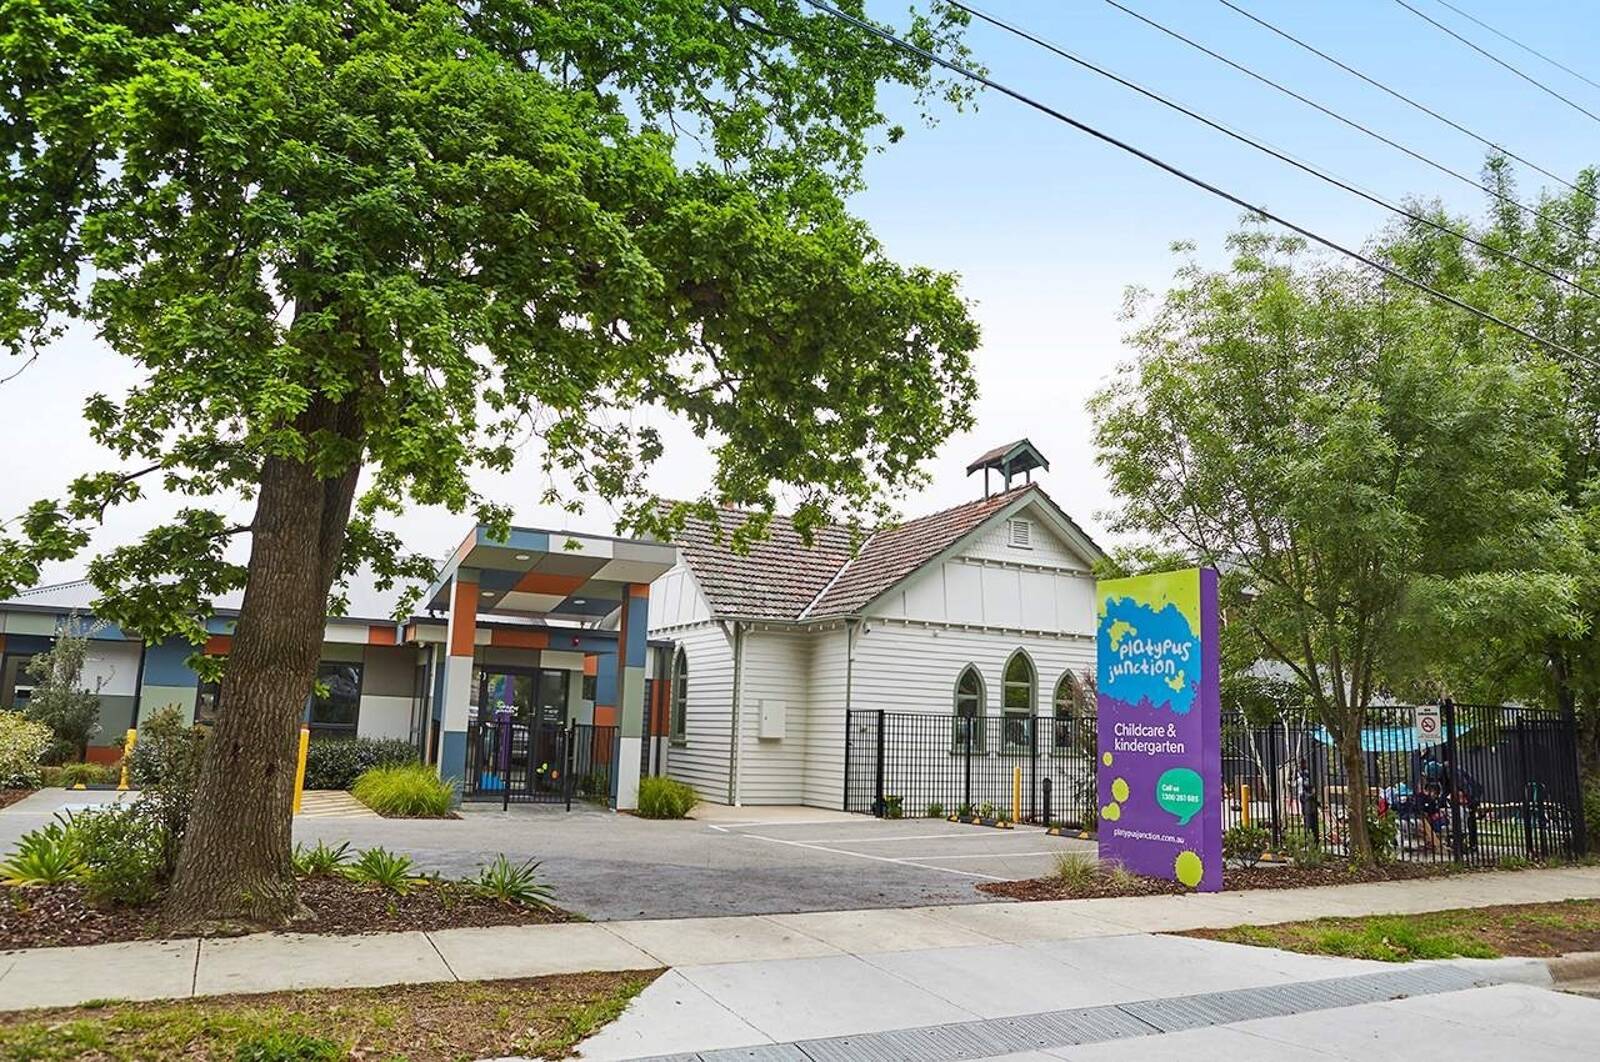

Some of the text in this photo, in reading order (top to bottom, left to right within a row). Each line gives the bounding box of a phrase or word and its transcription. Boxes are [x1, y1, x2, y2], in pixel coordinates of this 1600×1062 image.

[1108, 659, 1175, 683] junction
[1114, 723, 1177, 738] Childcare &
[1114, 738, 1185, 755] kindergarten
[1161, 783, 1172, 792] Call
